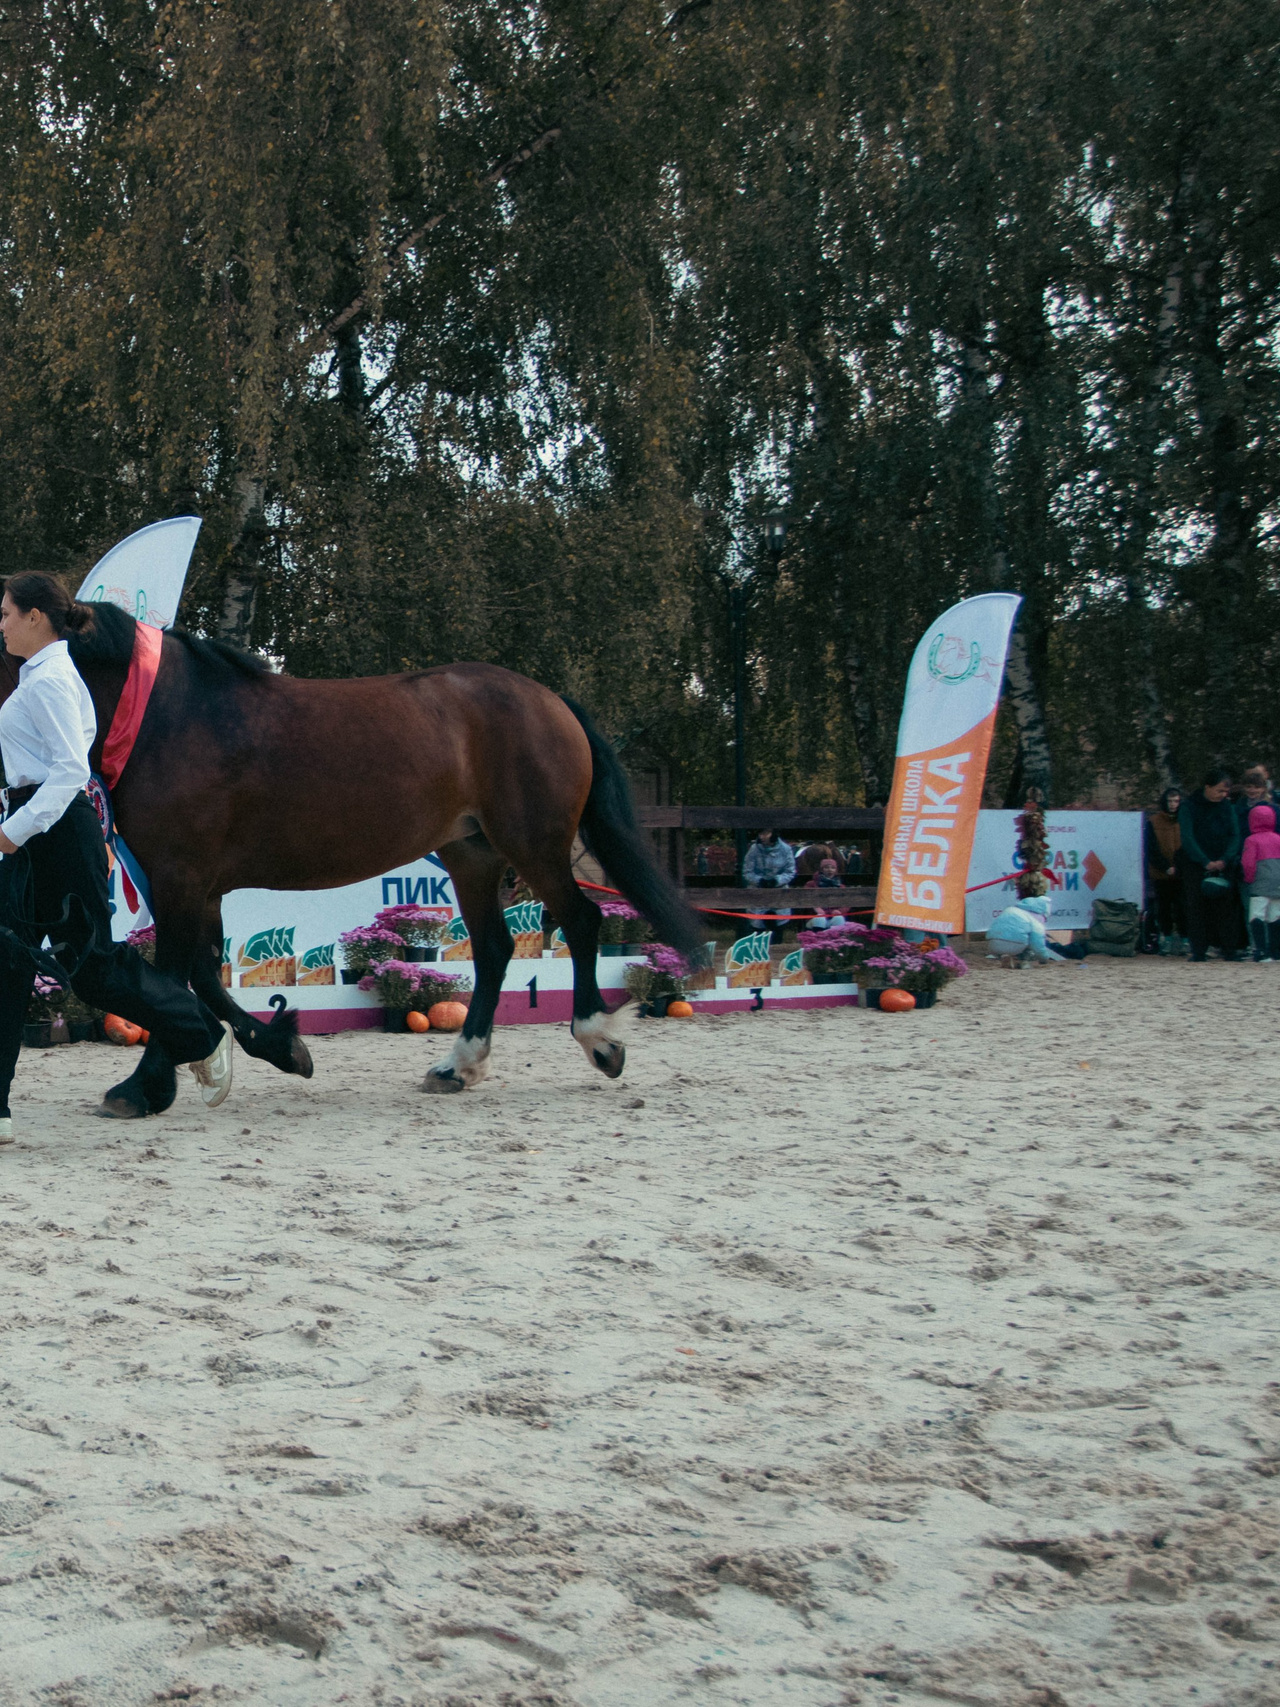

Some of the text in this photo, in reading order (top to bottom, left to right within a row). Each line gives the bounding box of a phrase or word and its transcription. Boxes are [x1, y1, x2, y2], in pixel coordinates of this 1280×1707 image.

[890, 759, 926, 904] СПОРТИВНАЯ ШКОЛА
[904, 752, 972, 910] БЕЛКА
[381, 876, 452, 905] ПИК
[268, 993, 288, 1025] 2
[525, 975, 538, 1009] 1
